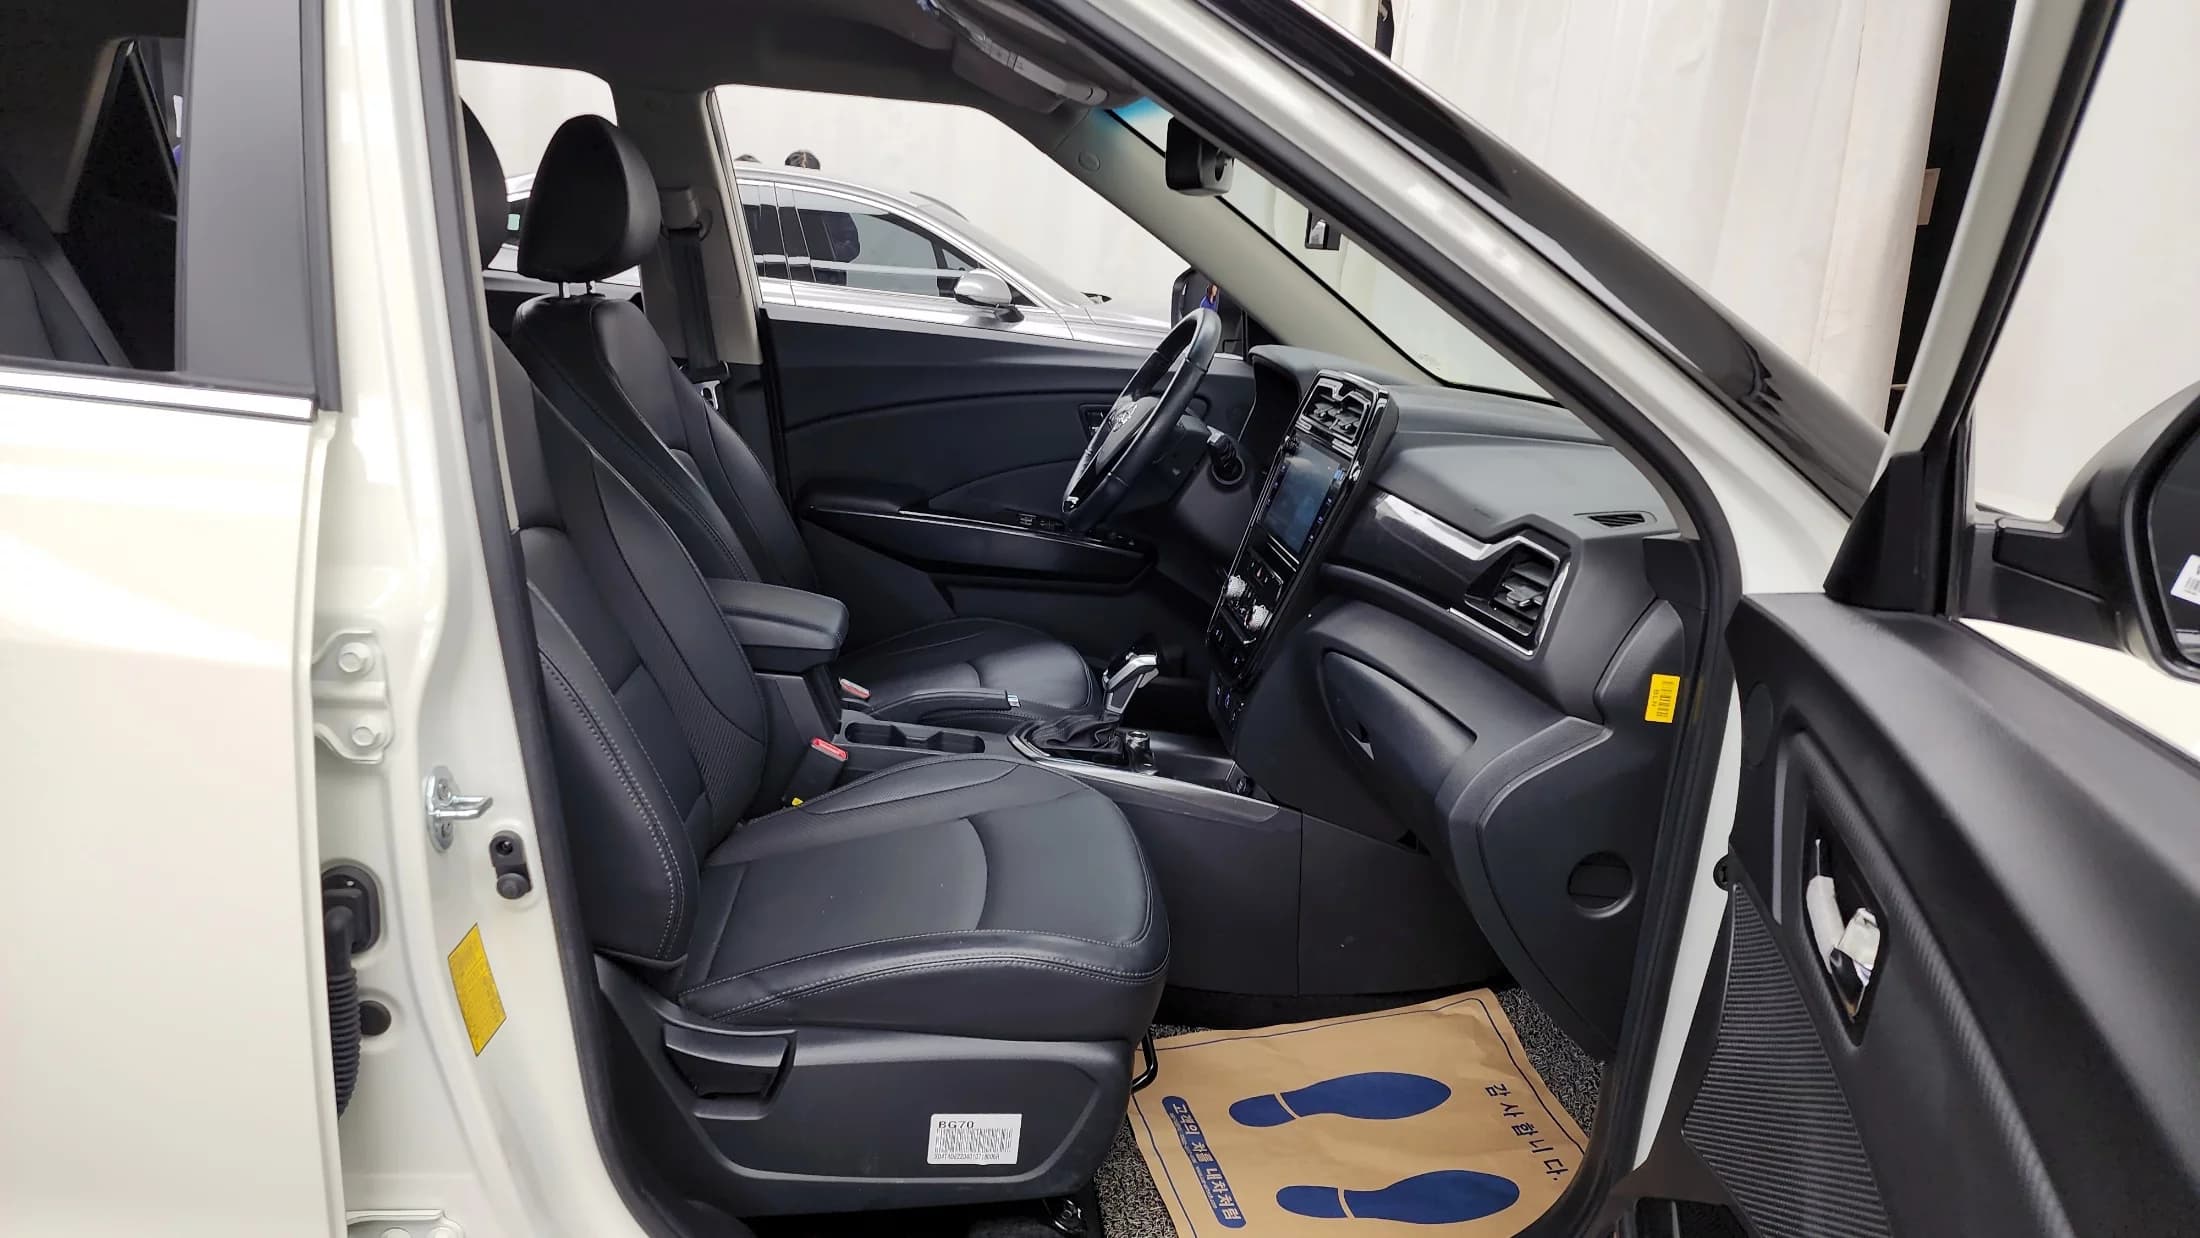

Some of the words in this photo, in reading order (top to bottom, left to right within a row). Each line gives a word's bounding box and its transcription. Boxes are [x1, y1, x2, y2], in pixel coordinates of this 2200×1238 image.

[938, 1120, 975, 1129] BG70
[1172, 1103, 1201, 1135] 고객의
[1191, 1141, 1214, 1163] 차를
